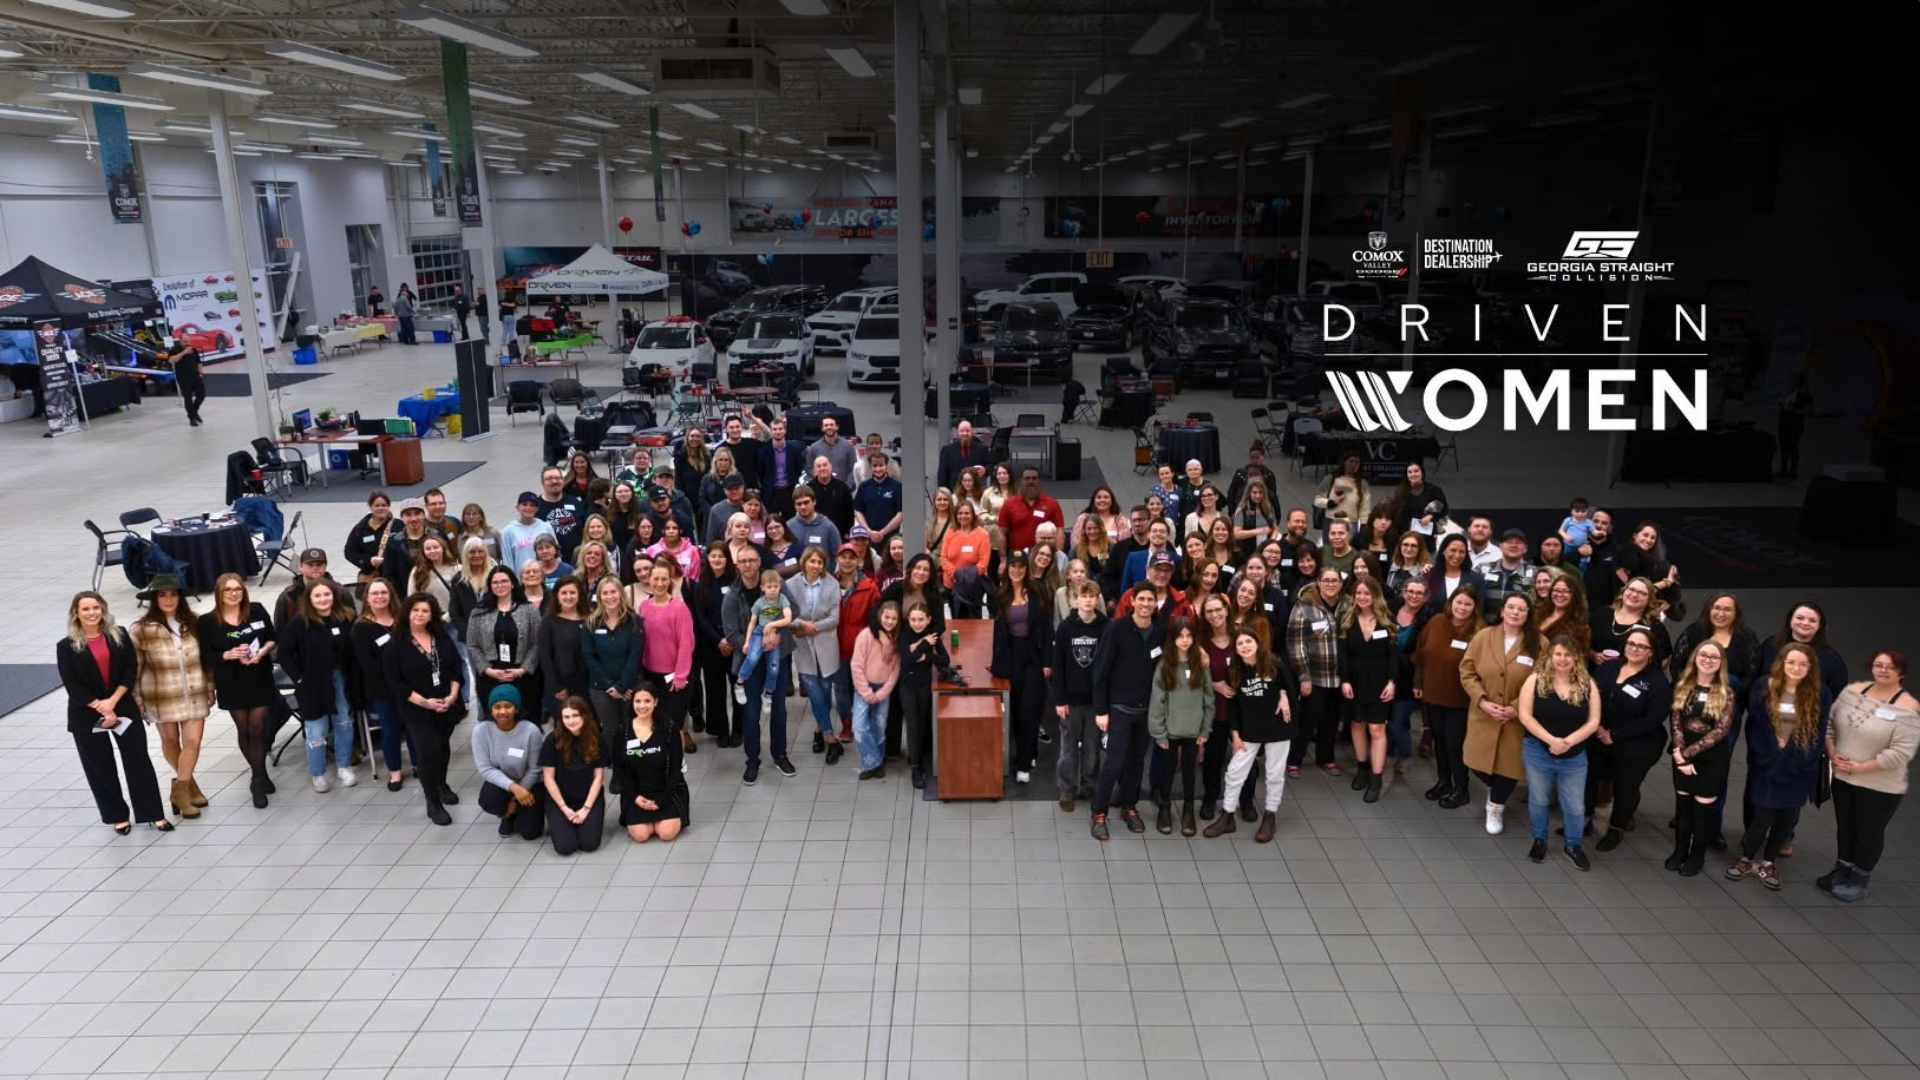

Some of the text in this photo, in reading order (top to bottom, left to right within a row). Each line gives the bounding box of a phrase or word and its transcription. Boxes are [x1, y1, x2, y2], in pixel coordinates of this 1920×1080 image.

[1089, 251, 1110, 265] EXIT
[557, 269, 620, 278] DRIVEN
[162, 282, 188, 291] Evolution
[528, 282, 572, 292] DRIVEN
[176, 290, 209, 301] MOPAR
